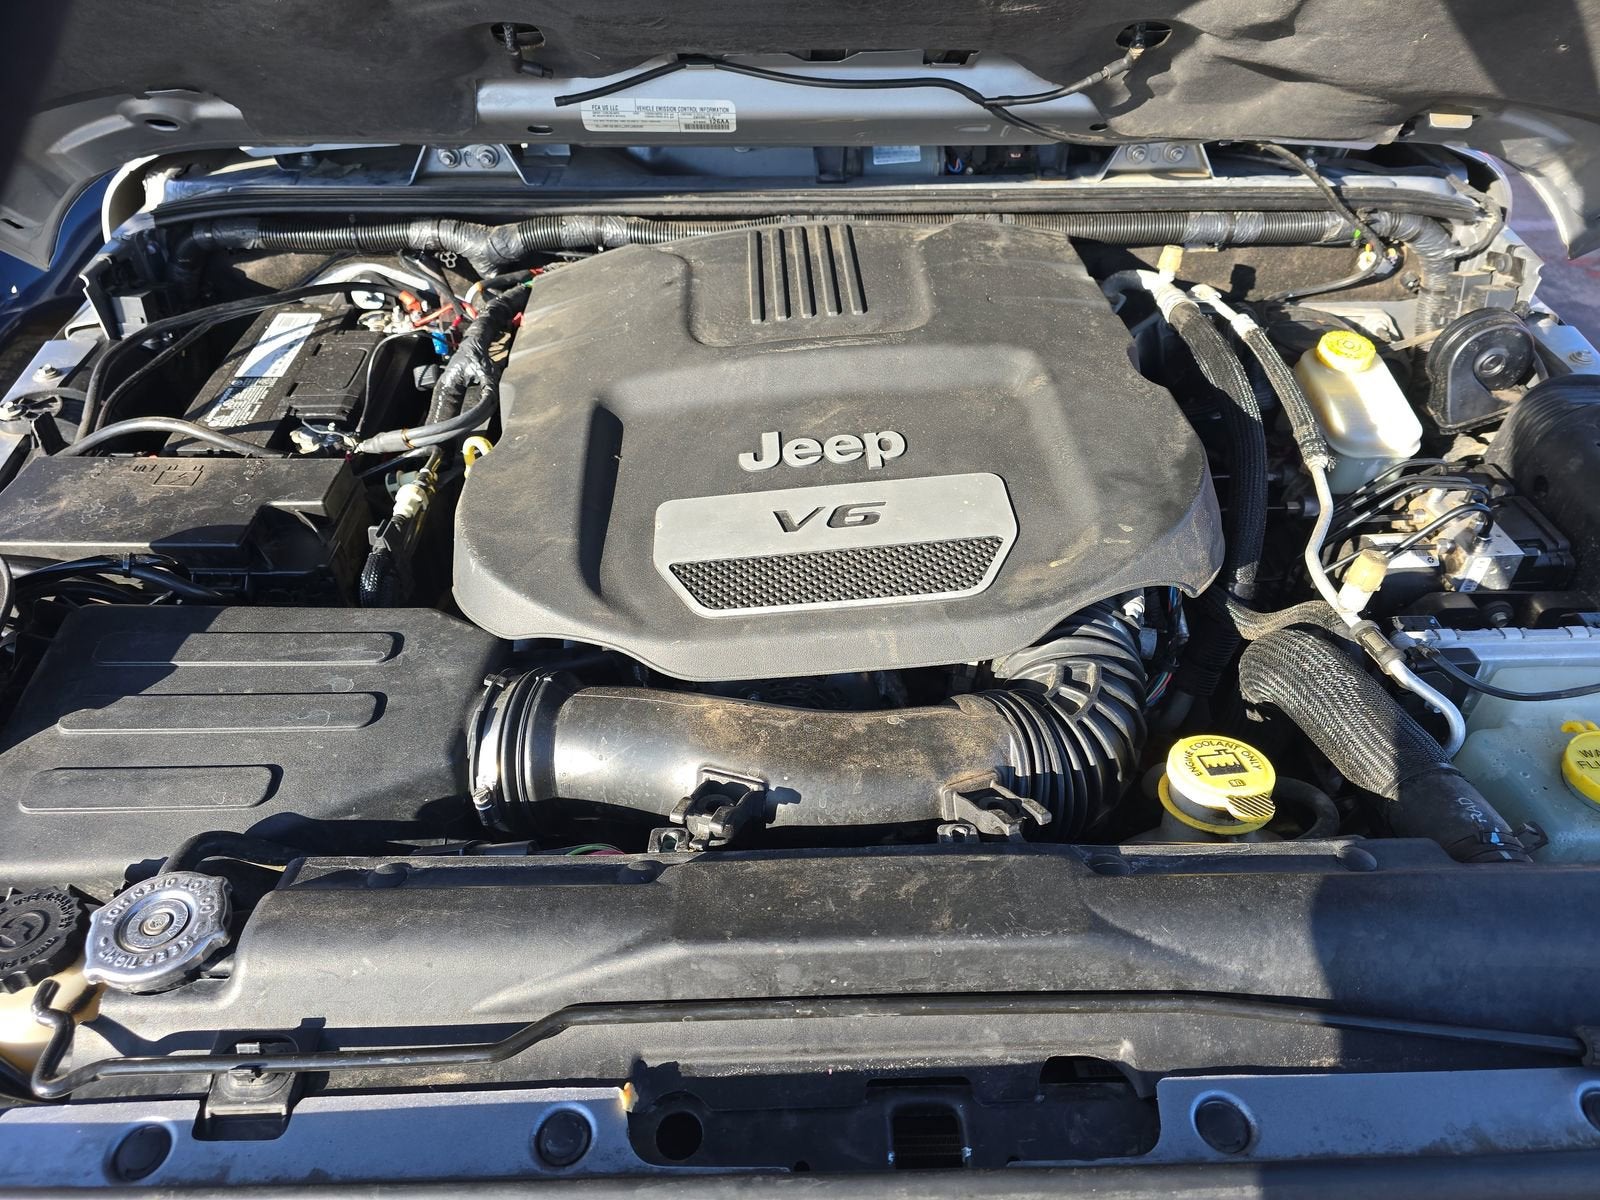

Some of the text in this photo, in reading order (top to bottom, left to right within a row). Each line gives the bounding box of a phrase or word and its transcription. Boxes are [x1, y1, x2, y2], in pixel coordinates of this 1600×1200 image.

[738, 431, 907, 472] Jeep
[773, 501, 887, 533] V6
[1183, 740, 1263, 777] ENGINE COOLANT ONLY
